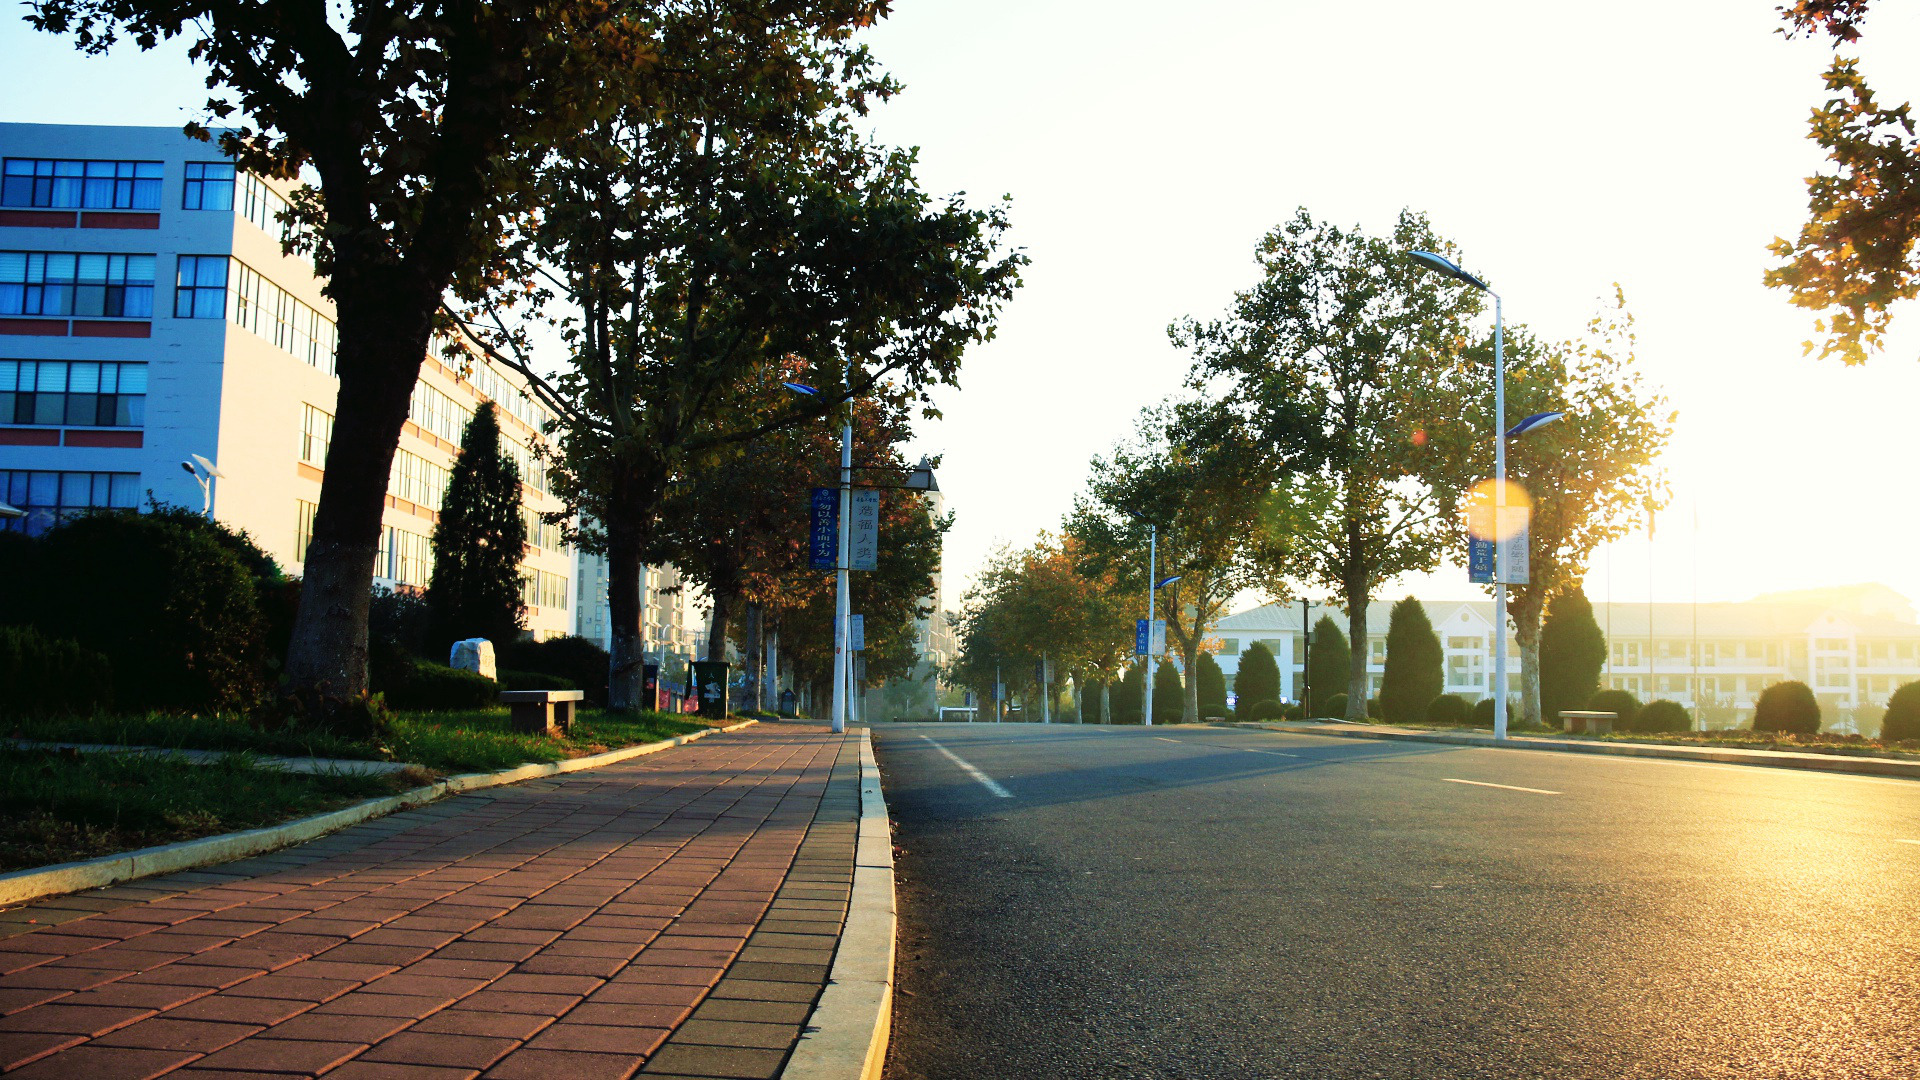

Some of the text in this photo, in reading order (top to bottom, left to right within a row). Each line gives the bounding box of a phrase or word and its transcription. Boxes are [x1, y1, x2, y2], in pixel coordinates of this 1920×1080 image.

[817, 503, 832, 557] 勿以善小而不为
[857, 505, 873, 559] 造福人类
